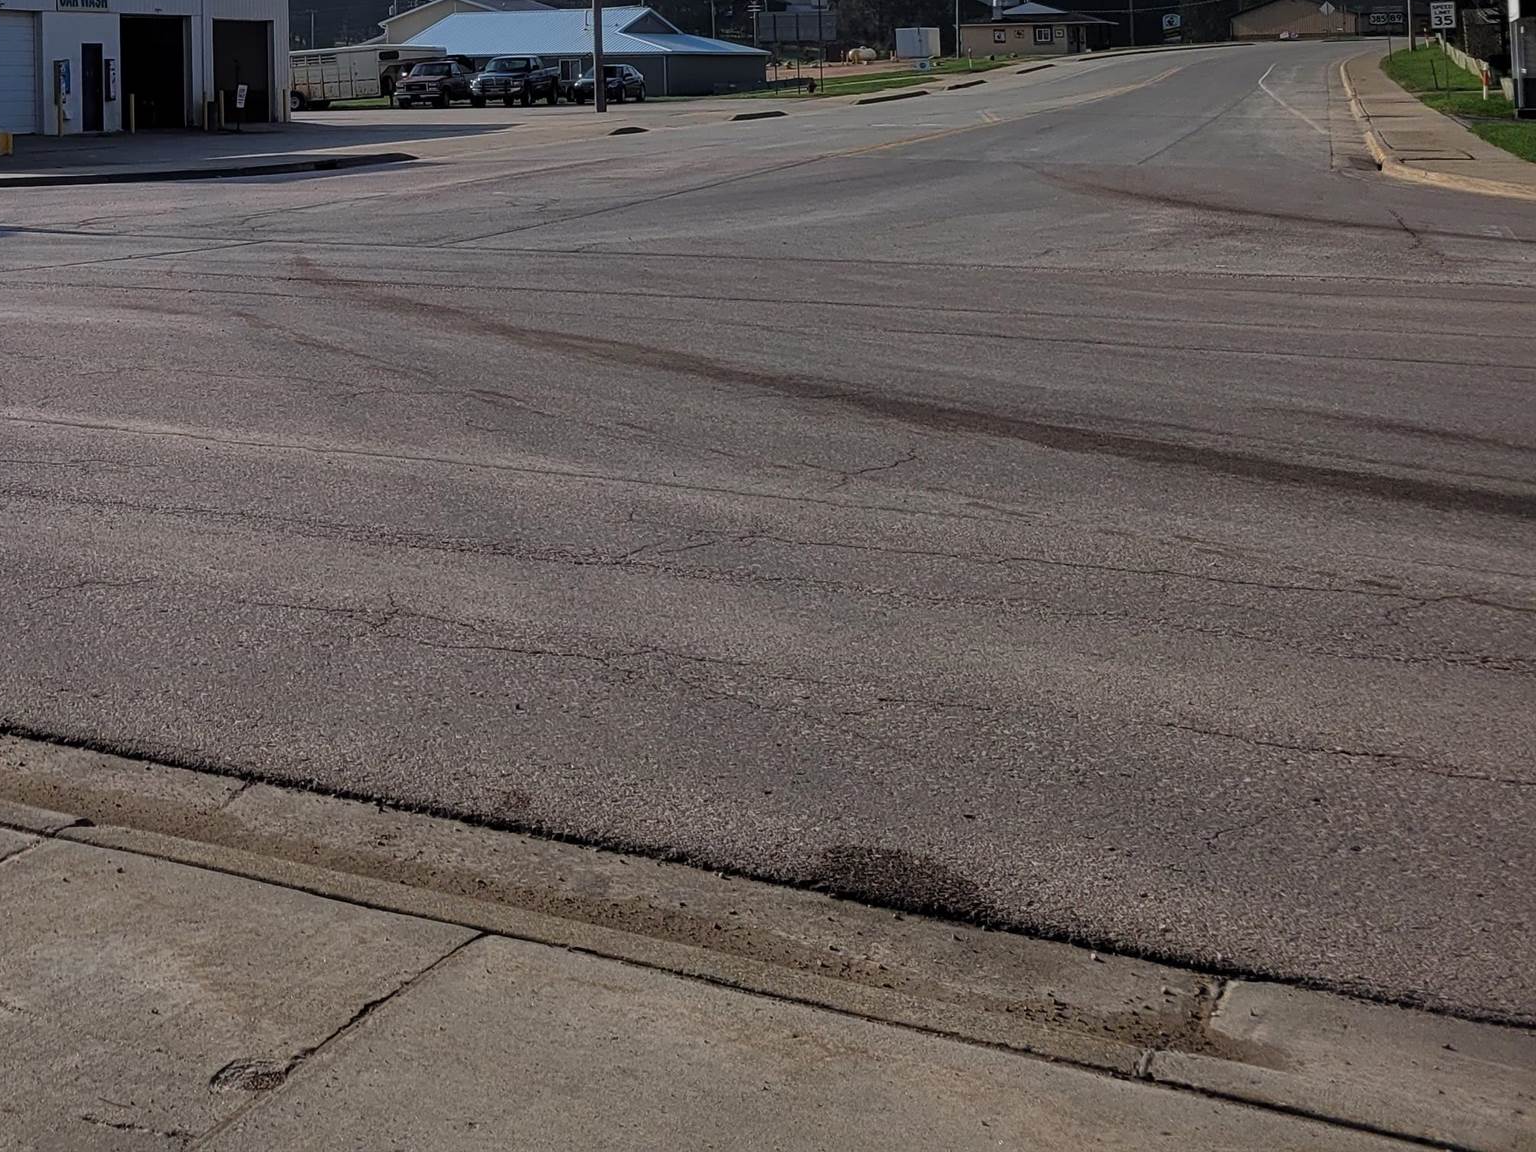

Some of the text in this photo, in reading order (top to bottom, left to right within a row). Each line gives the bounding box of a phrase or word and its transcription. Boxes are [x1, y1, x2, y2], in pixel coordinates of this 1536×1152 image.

[1371, 15, 1386, 23] 385
[1390, 14, 1402, 22] 89
[1434, 15, 1453, 26] 35
